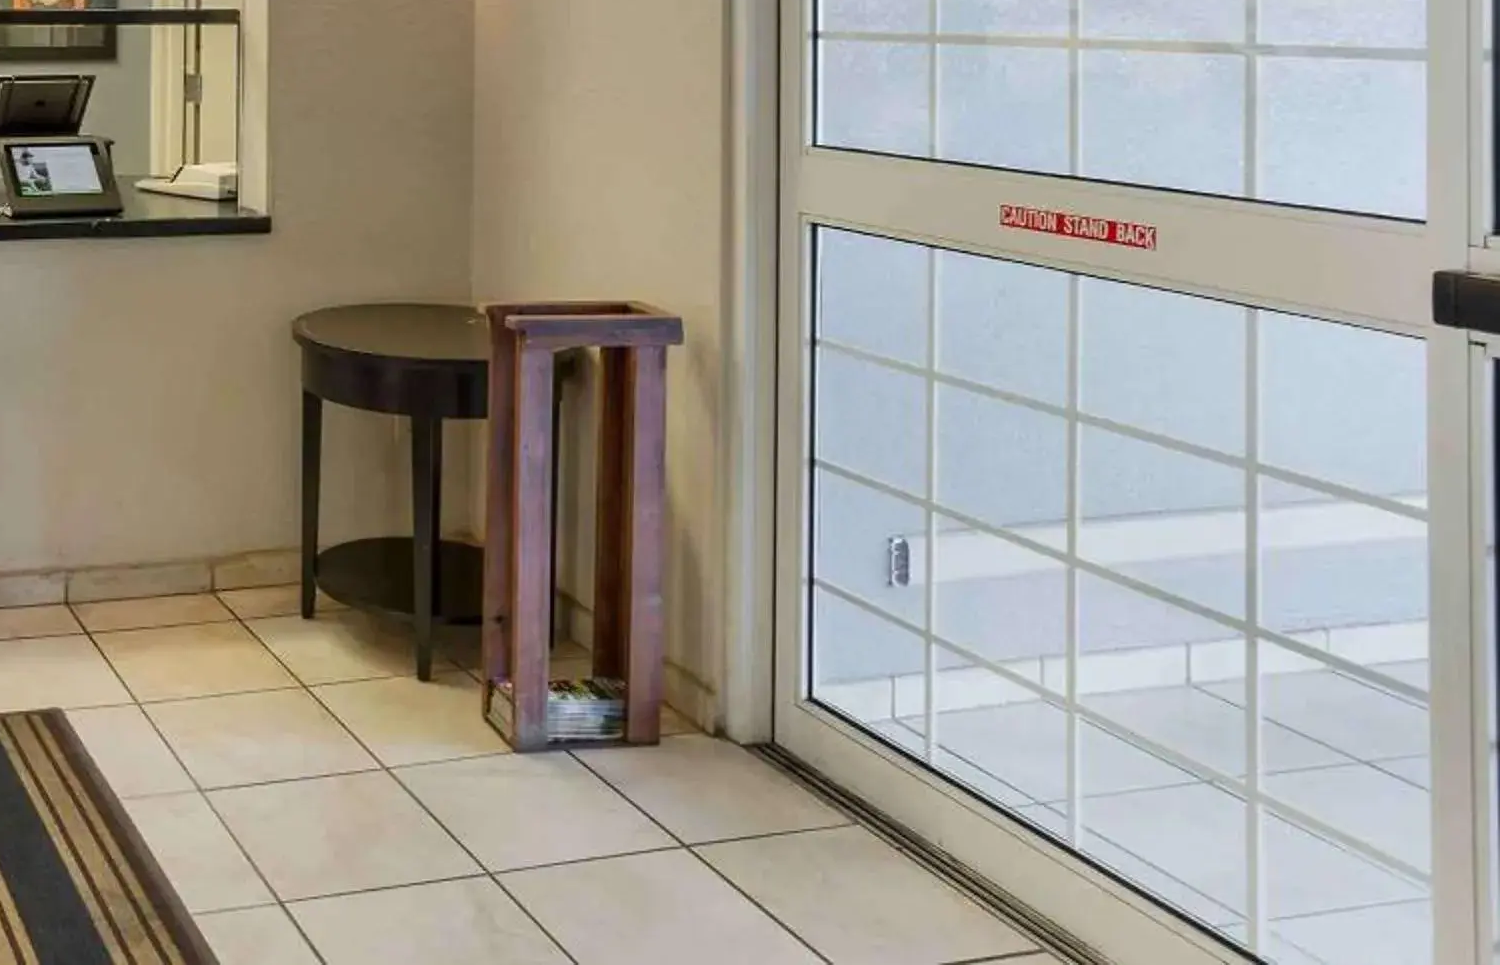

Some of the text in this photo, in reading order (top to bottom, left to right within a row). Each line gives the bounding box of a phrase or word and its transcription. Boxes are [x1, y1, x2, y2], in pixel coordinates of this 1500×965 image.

[1000, 205, 1158, 250] CAUTION STAND BACK
